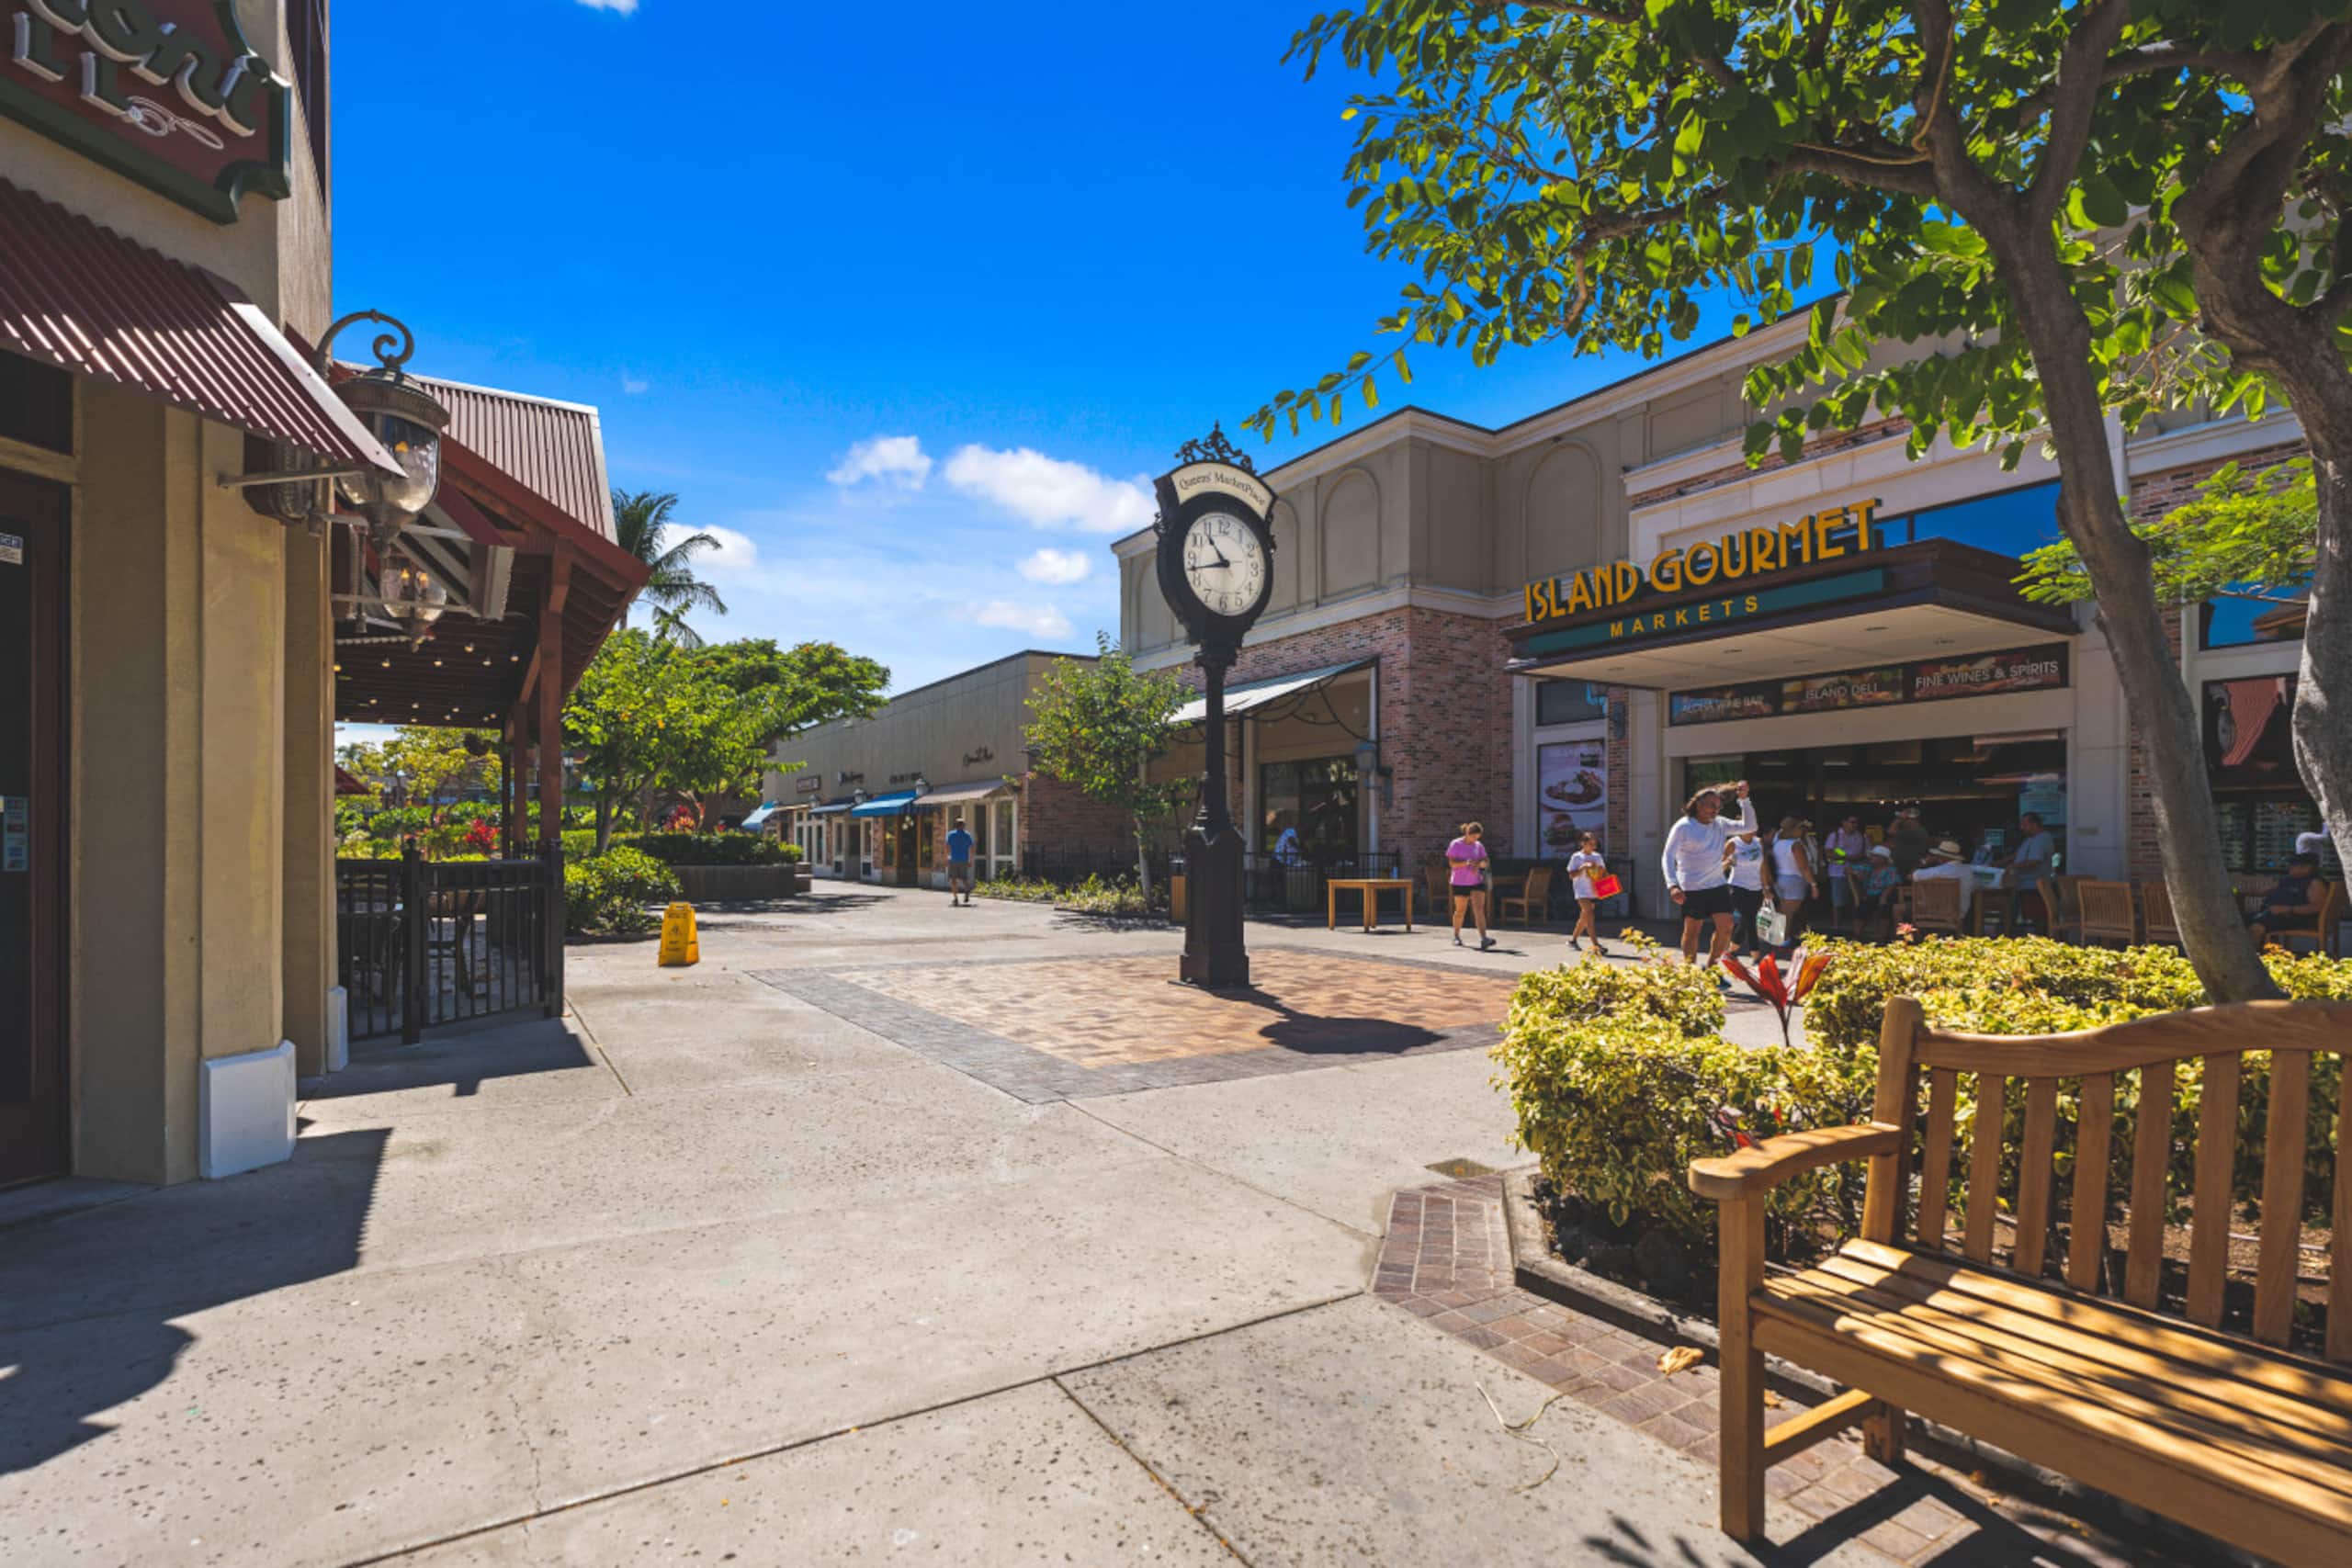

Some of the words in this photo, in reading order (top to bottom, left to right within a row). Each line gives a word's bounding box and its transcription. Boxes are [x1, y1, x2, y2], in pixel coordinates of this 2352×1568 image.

[1218, 519, 1231, 534] 12
[1248, 544, 1255, 558] 2
[1524, 559, 1640, 623] ISLAND
[1649, 498, 1878, 592] GOURMET
[1250, 562, 1259, 577] 3
[1204, 588, 1212, 603] 7
[1219, 593, 1228, 610] 6
[1610, 595, 1758, 638] MARKETS
[1915, 674, 1945, 689] FINE
[1948, 670, 1991, 685] WINES
[1995, 667, 2006, 679] &
[2009, 660, 2059, 677] SPIRITS
[1805, 685, 1848, 701] ISLAND
[1851, 682, 1878, 695] DELI
